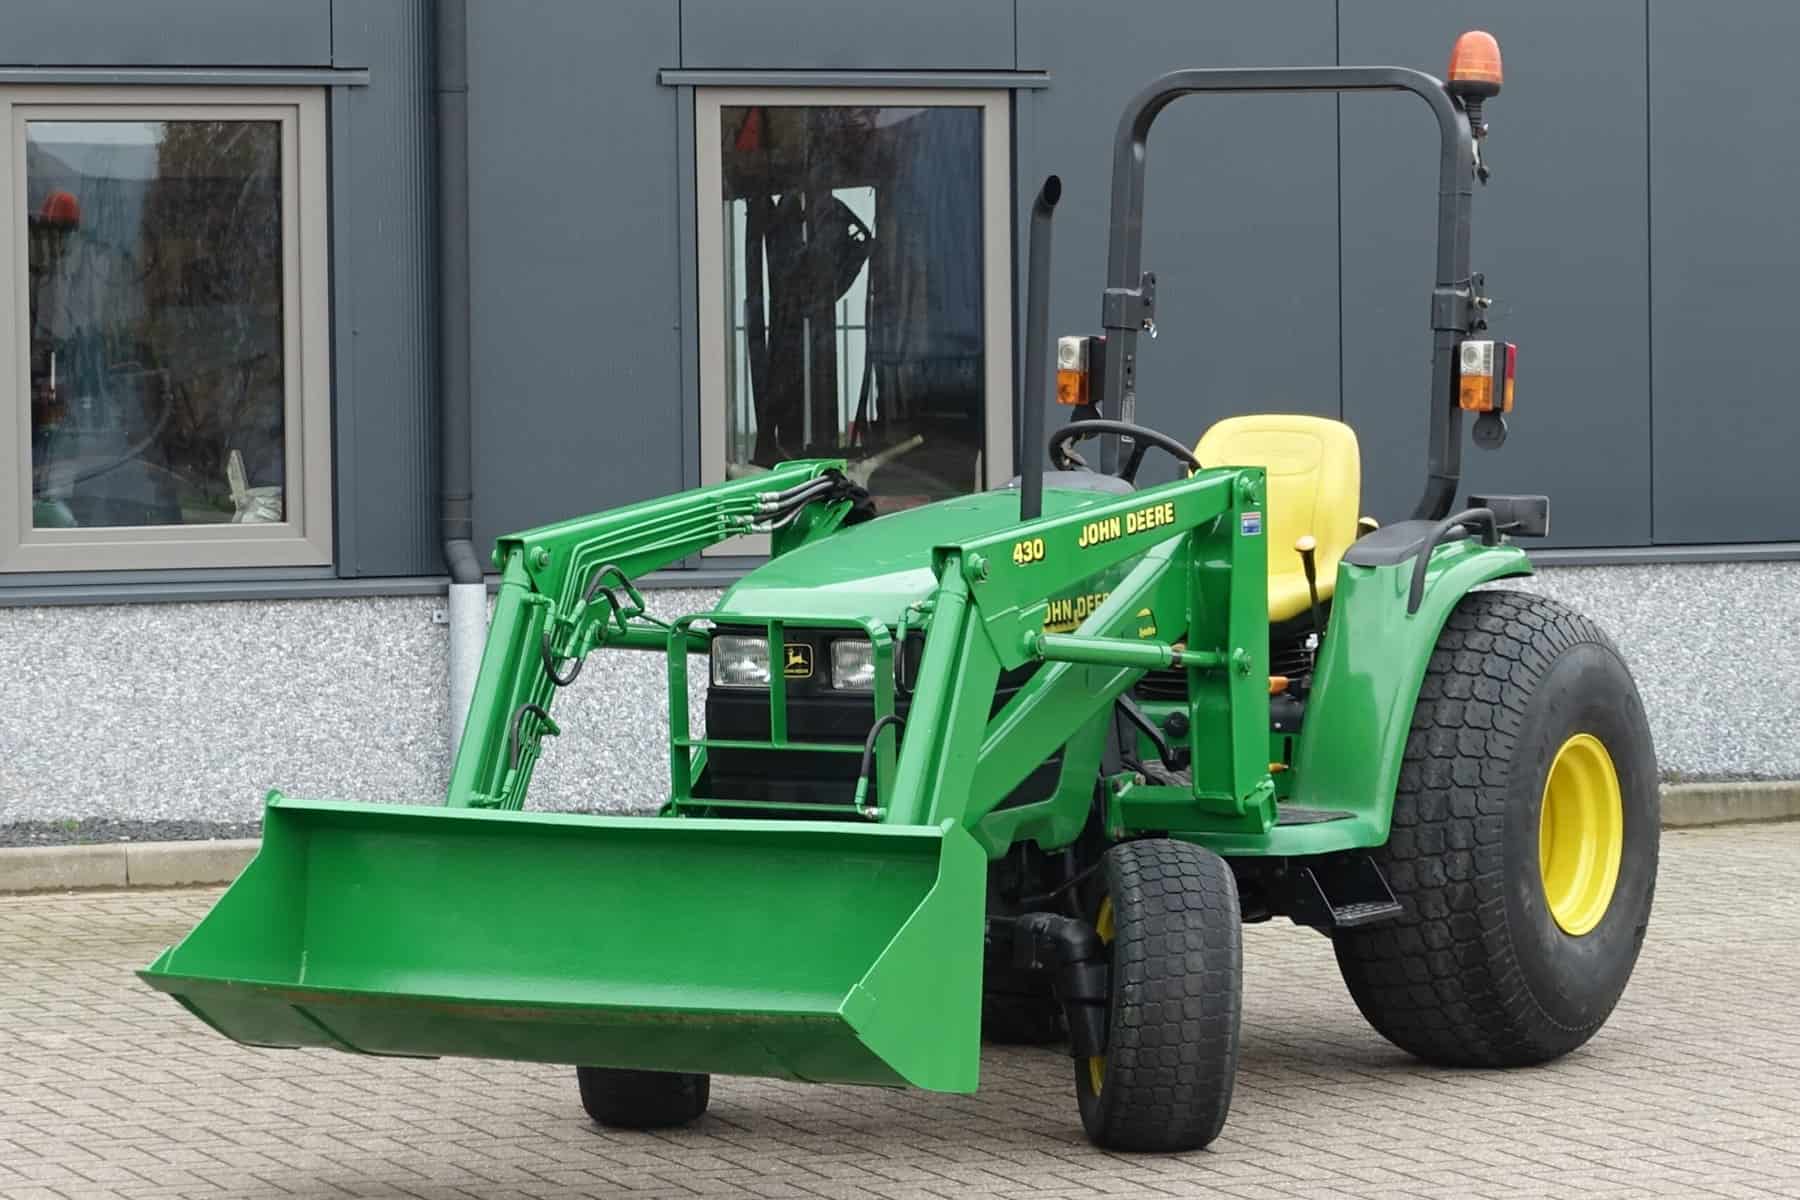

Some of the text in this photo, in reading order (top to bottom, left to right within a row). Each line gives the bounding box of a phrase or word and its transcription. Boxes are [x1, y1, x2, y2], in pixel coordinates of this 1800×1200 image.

[1079, 502, 1175, 548] JOHN DEERE
[1013, 538, 1044, 564] 430
